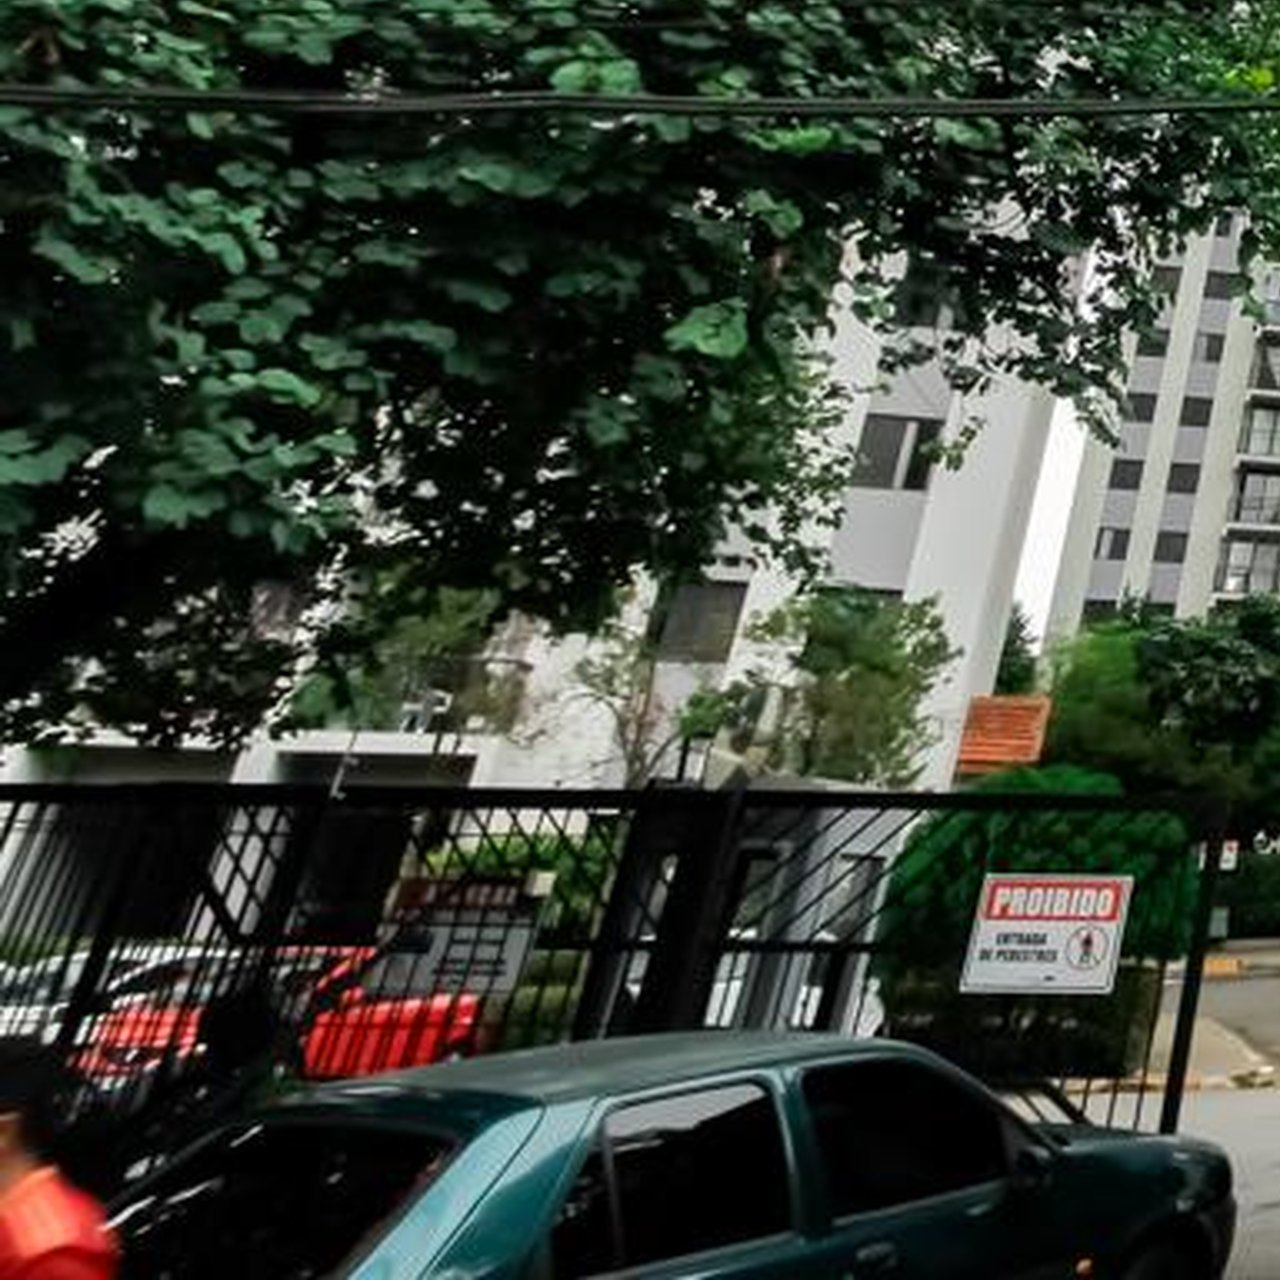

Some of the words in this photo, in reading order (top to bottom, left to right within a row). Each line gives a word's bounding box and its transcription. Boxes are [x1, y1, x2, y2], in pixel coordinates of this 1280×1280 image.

[990, 886, 1117, 918] PROIBIDO
[996, 932, 1048, 946] ENTRADA
[978, 949, 992, 962] DE
